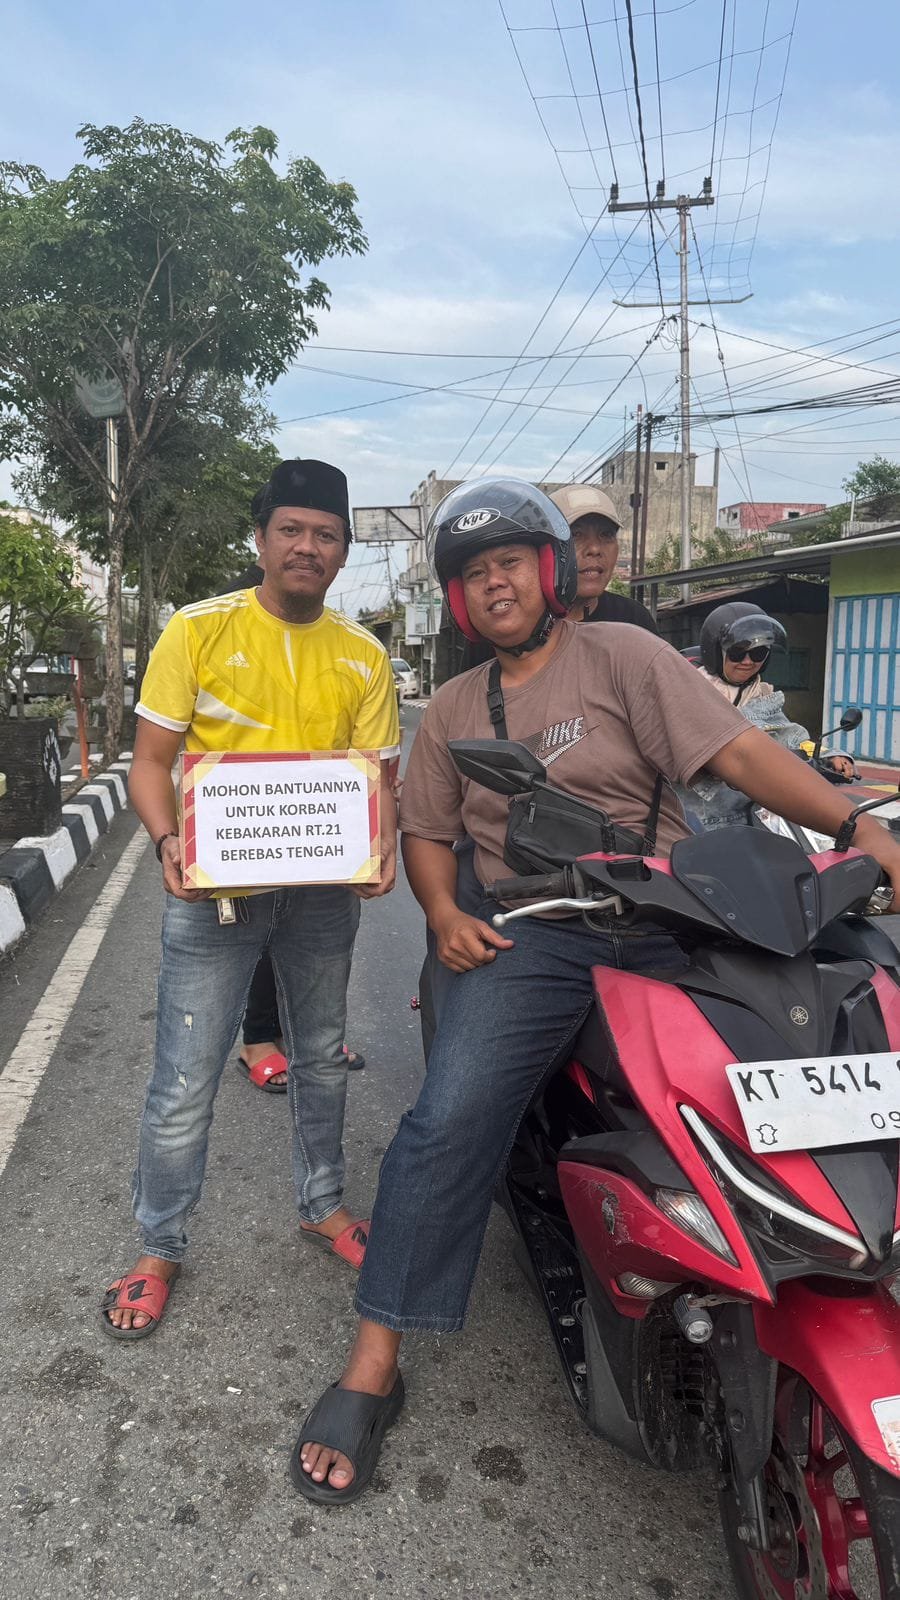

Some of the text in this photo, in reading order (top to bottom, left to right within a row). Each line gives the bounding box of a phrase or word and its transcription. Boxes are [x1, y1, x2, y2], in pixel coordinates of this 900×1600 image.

[541, 716, 584, 750] NIKE
[202, 780, 361, 798] MOHON BANTUANNYA
[225, 802, 337, 818] UNTUK KORBAN
[216, 823, 342, 840] KEBAKARAN RT.21
[221, 844, 344, 862] BEREBAS TENGAH
[736, 1062, 881, 1102] KT 5414
